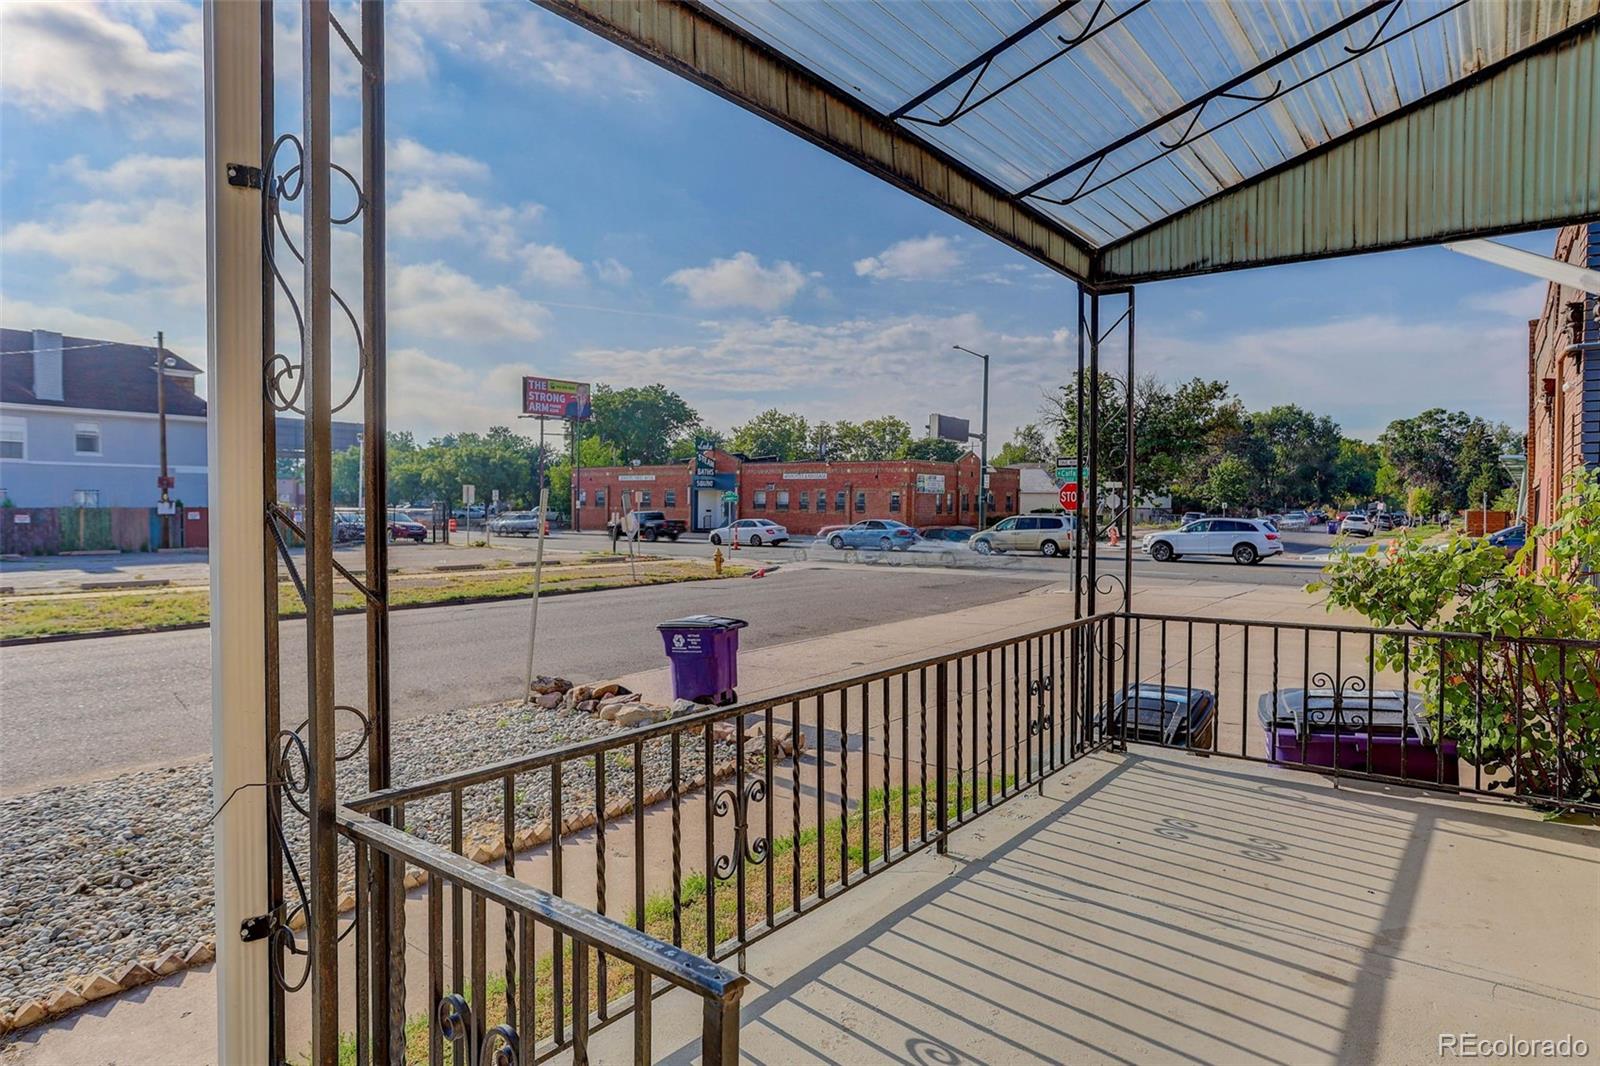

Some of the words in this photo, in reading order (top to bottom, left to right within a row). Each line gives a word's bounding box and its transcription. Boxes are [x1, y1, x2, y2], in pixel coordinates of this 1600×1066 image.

[528, 380, 547, 390] THE
[528, 391, 566, 403] STRONG
[528, 402, 549, 412] ARM
[697, 468, 714, 476] BATHS
[1060, 491, 1078, 502] STO
